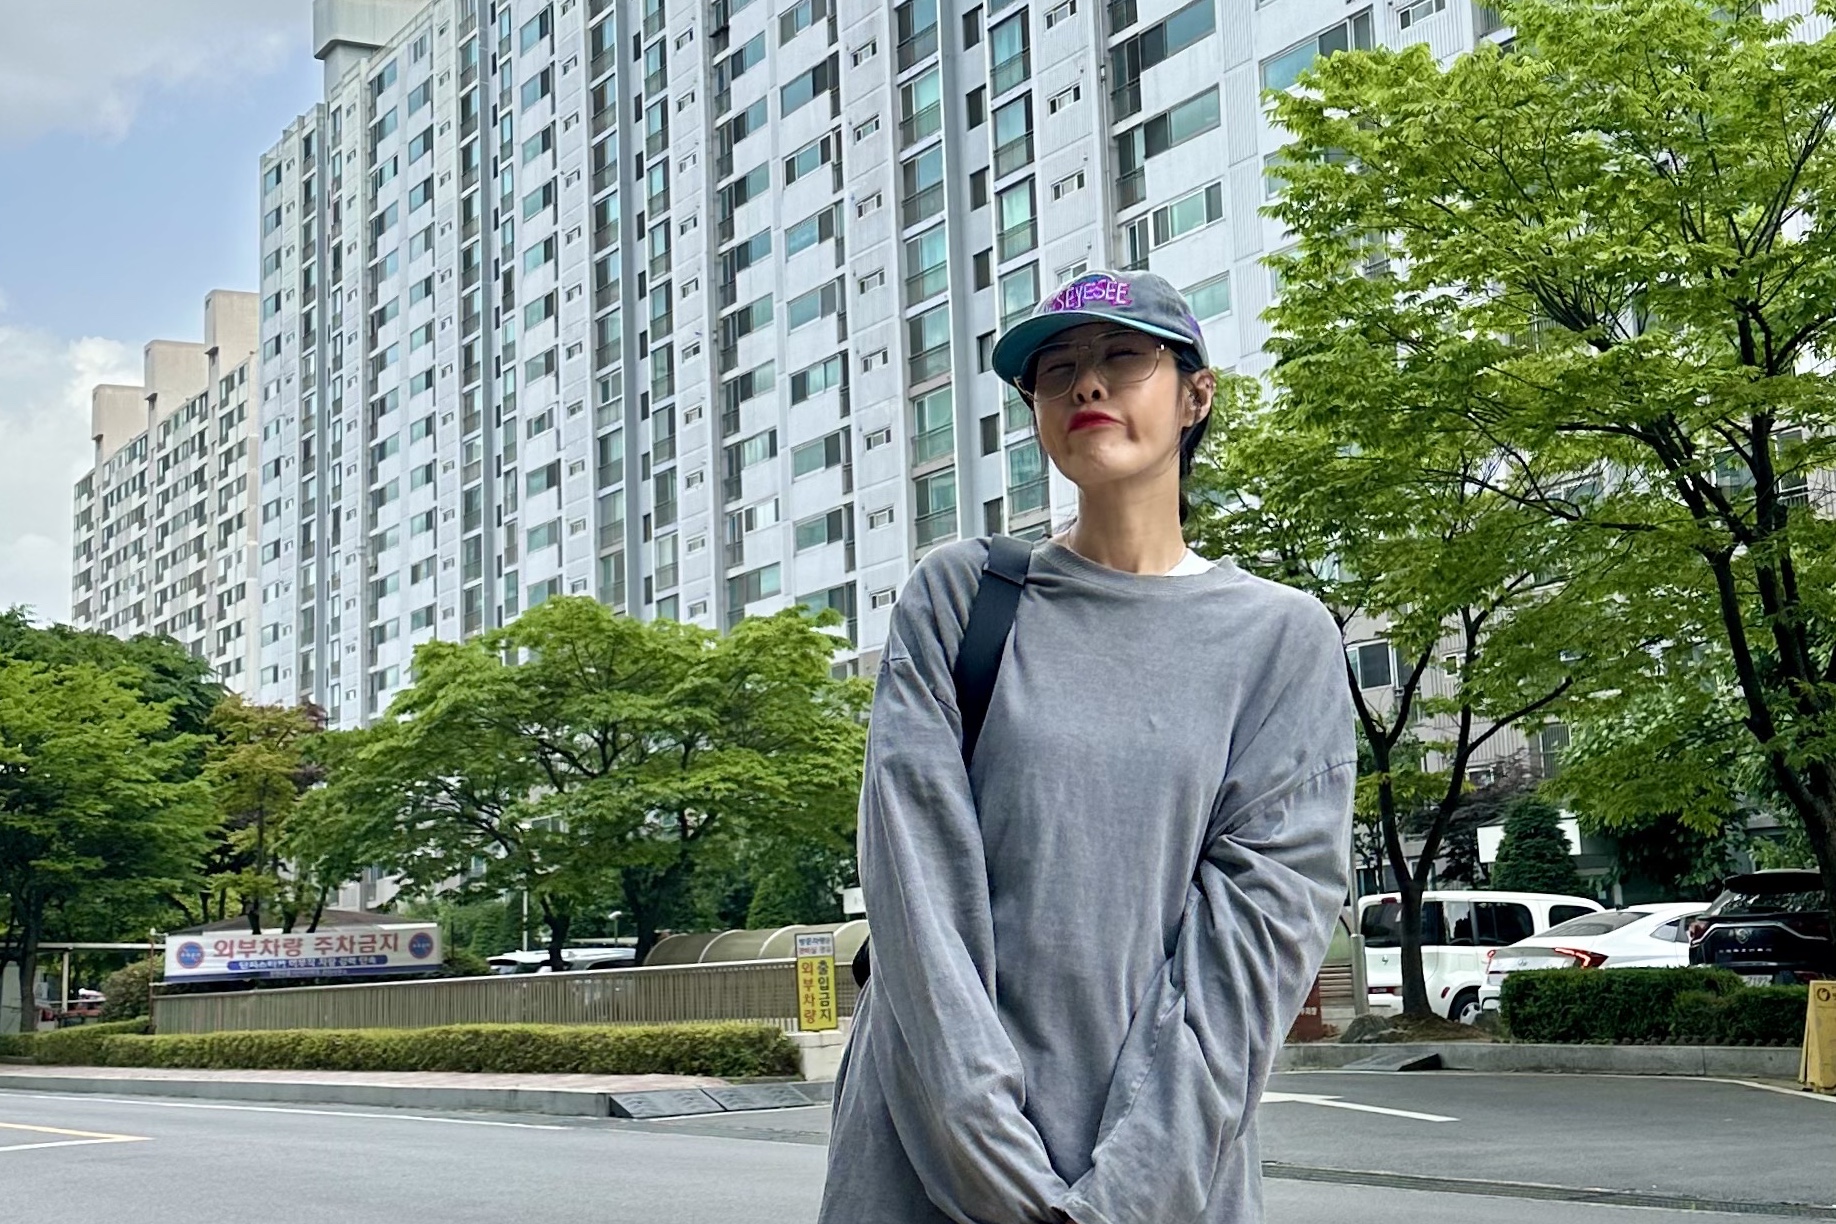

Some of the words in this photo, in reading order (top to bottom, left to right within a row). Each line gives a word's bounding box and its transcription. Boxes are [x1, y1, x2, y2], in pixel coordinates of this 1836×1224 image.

[213, 936, 303, 959] 외부차량
[314, 932, 398, 955] 주차금지
[801, 961, 816, 1024] 외부차량
[817, 959, 832, 1022] 출입금지
